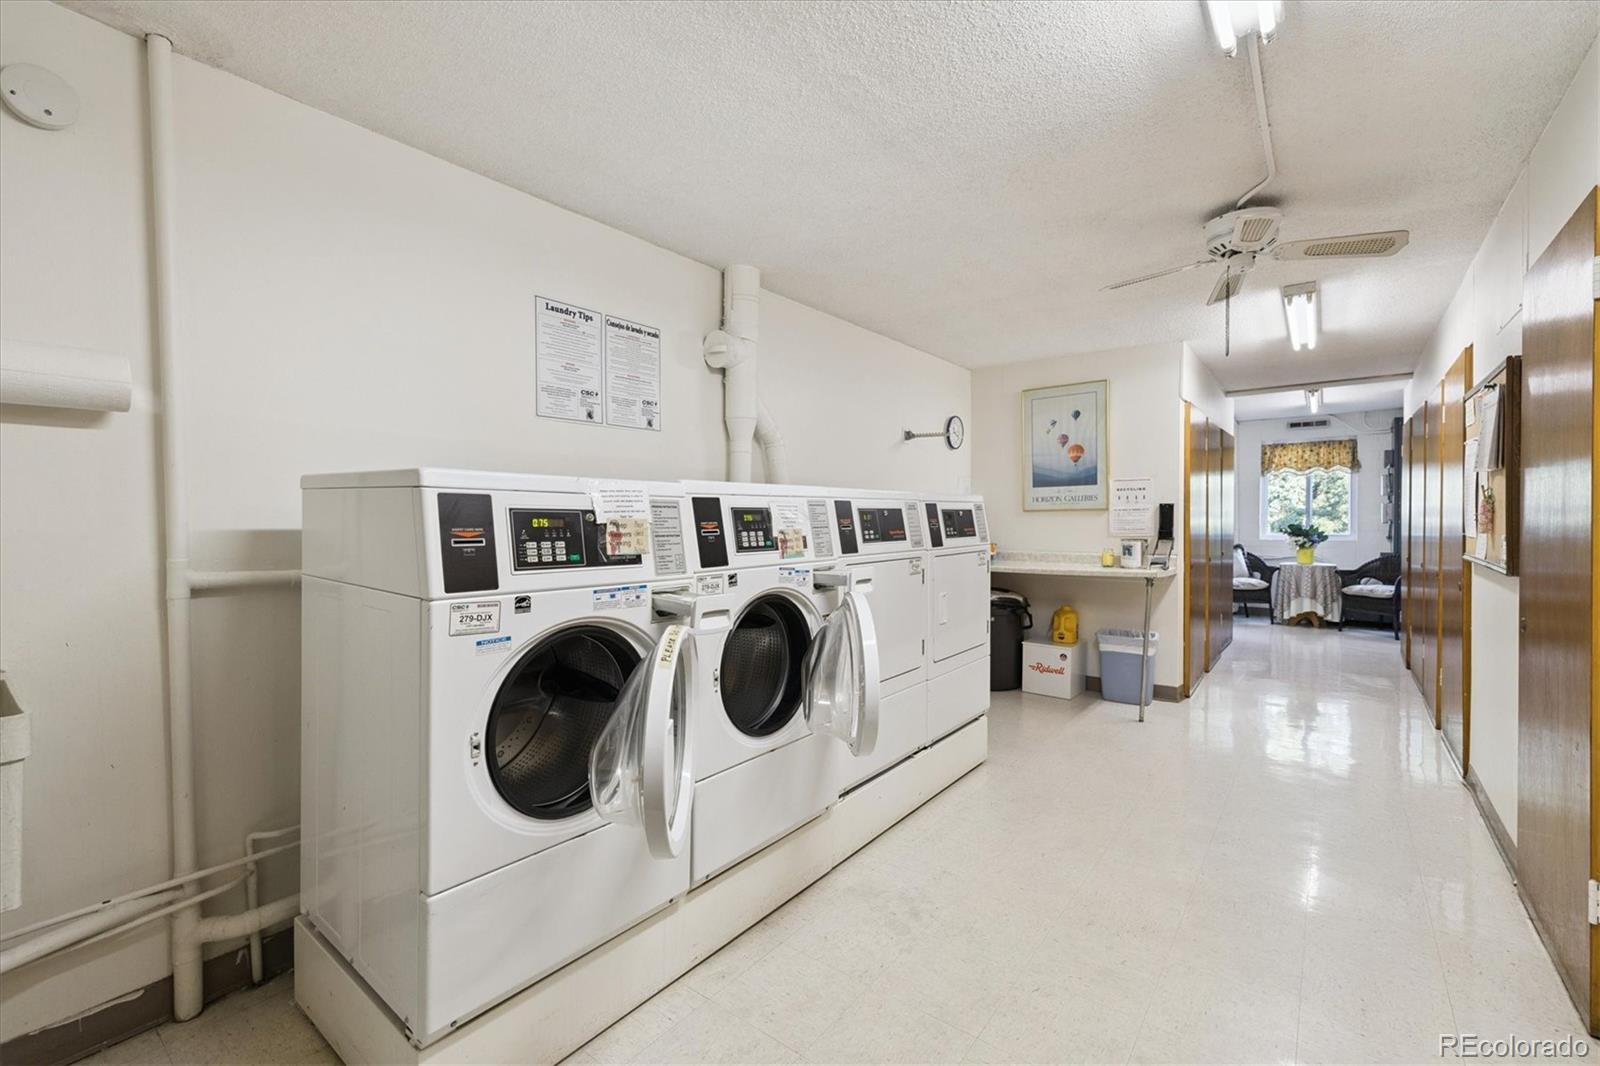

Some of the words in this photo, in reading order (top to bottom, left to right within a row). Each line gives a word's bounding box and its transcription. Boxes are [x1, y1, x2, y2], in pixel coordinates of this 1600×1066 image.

[545, 302, 577, 319] Laundry
[578, 311, 594, 322] Tips
[580, 389, 594, 397] CSC
[642, 399, 654, 407] CSC
[459, 613, 493, 623] 279-DJX
[1034, 662, 1066, 676] Ridwell
